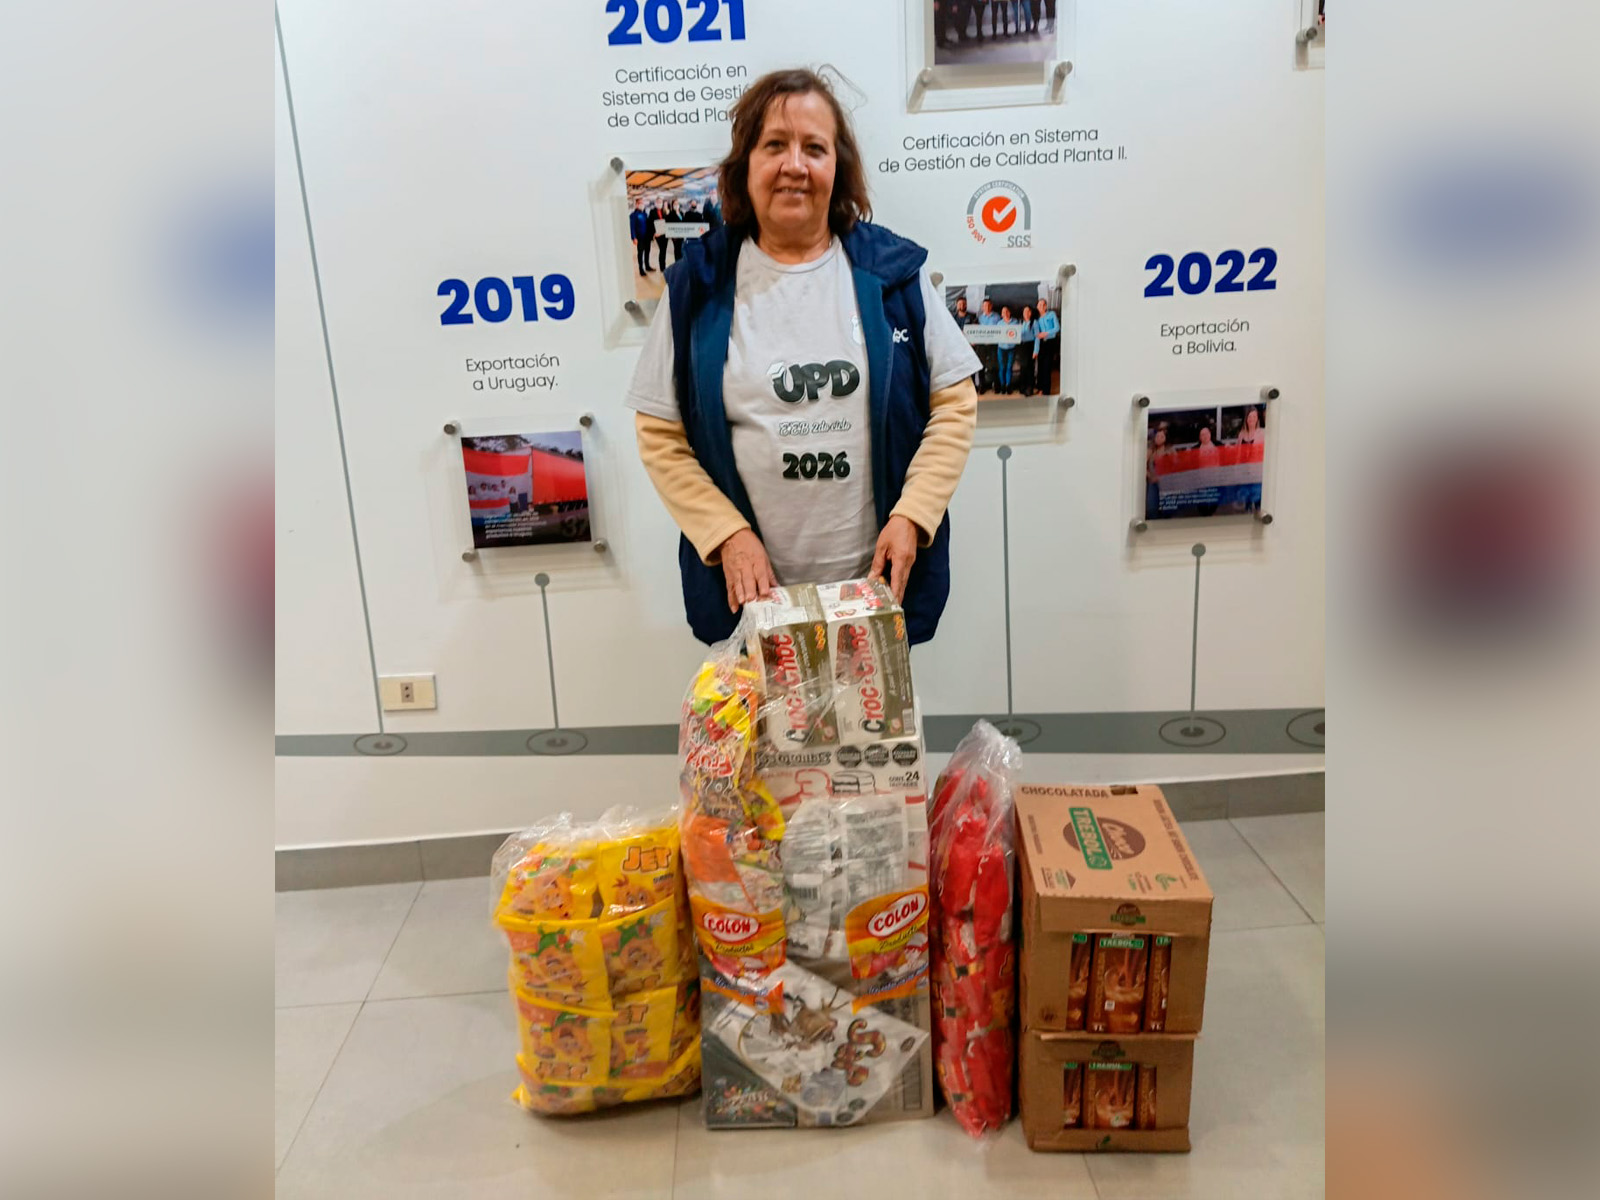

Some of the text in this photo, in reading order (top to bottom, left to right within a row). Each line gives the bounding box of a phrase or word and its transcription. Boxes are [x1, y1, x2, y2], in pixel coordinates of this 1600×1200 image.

[605, 0, 746, 46] 2021
[615, 63, 748, 84] Certificación en
[602, 90, 669, 107] Sistema
[674, 87, 696, 103] de
[607, 112, 630, 128] de
[634, 108, 700, 127] Calidad
[902, 127, 1099, 150] Certificación en Sistema
[878, 157, 900, 173] de
[904, 153, 965, 172] Gestión
[970, 153, 991, 168] de
[995, 148, 1059, 167] Calidad
[1063, 147, 1113, 163] Planta
[966, 215, 987, 245] ISO 9001
[1007, 234, 1031, 249] SGS
[1143, 247, 1278, 298] 2022
[436, 273, 576, 326] 2019
[1160, 318, 1250, 340] Exportación
[1171, 338, 1238, 355] a Bolivia.
[465, 353, 560, 375] Exportación
[472, 374, 559, 393] a Uruguay.
[772, 359, 861, 403] UPD
[782, 450, 851, 481] 2026
[905, 771, 920, 782] 24
[1021, 785, 1110, 799] CHOCOLATADA
[1072, 808, 1104, 857] TREBOL
[622, 845, 672, 874] JET
[873, 896, 920, 933] COLON
[707, 918, 752, 935] COLON
